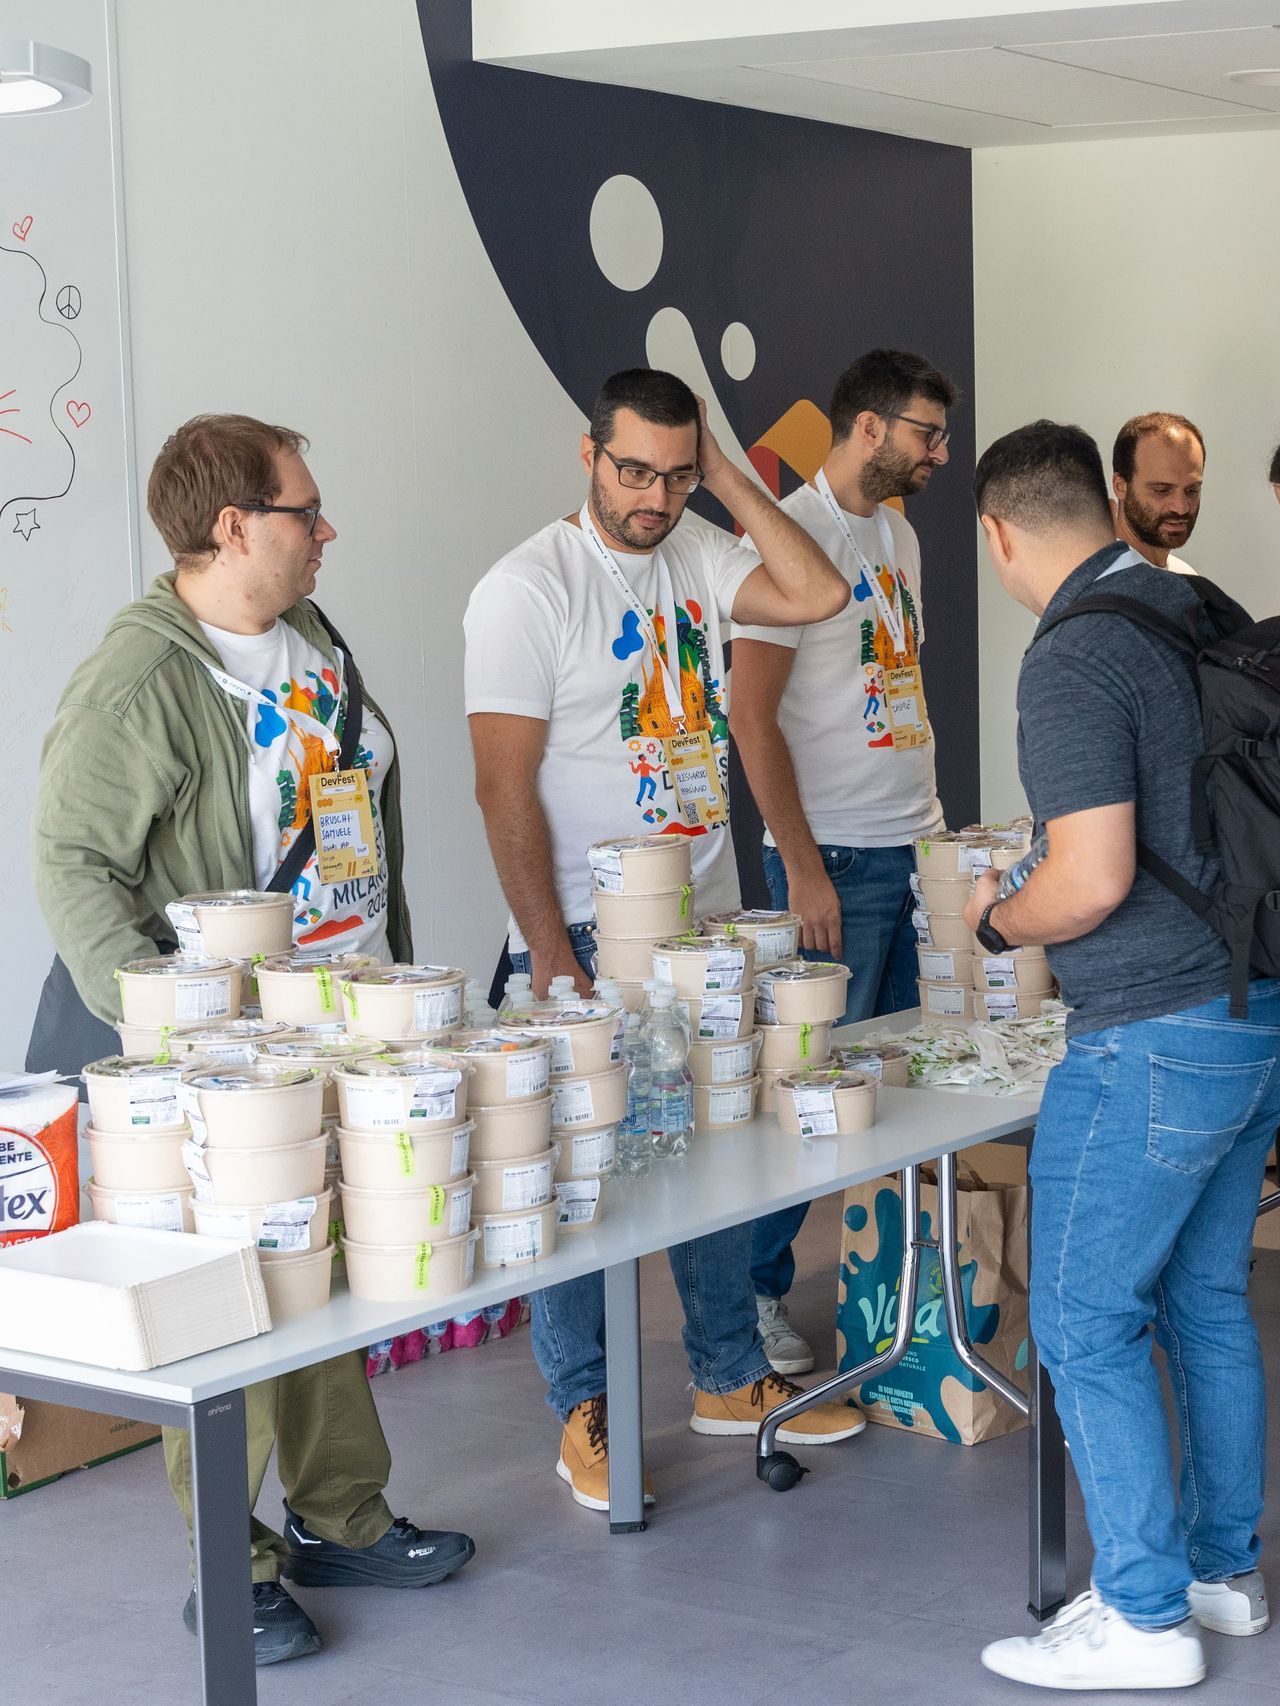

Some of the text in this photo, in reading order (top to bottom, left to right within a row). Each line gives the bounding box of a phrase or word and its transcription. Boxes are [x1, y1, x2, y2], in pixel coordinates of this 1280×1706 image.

[891, 670, 914, 679] DevFest
[671, 735, 701, 748] DevFest
[320, 773, 356, 787] DevFest
[321, 827, 352, 841] SAMUELE
